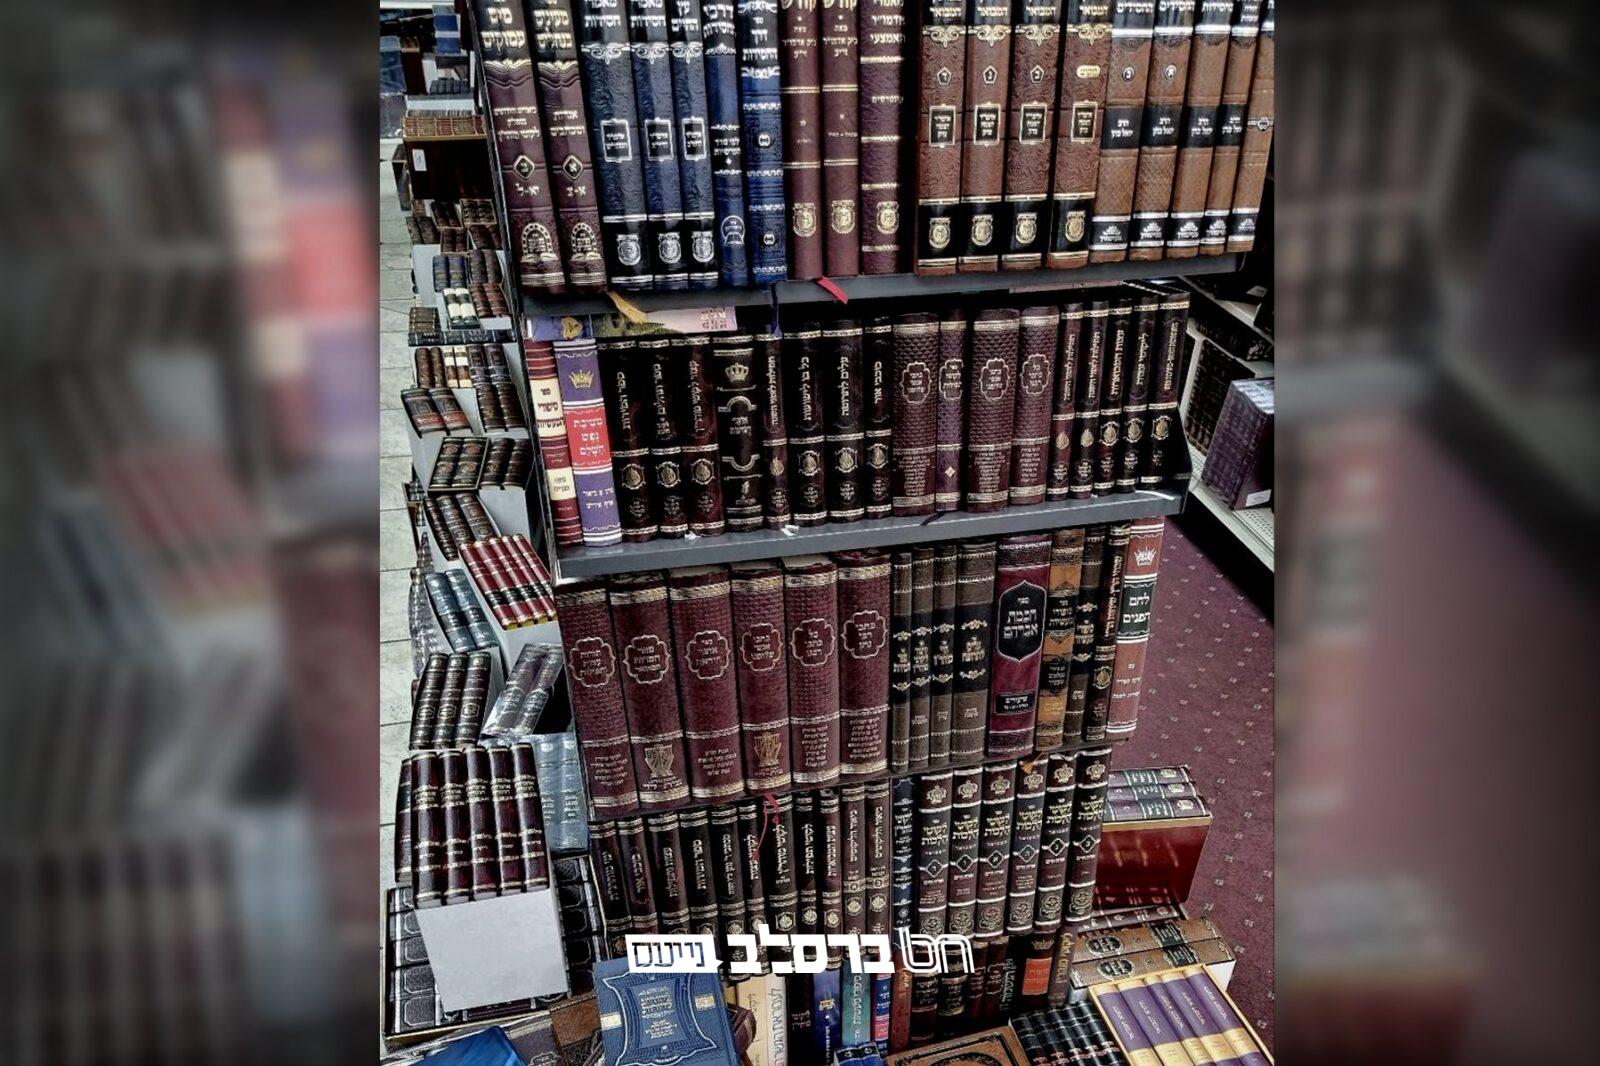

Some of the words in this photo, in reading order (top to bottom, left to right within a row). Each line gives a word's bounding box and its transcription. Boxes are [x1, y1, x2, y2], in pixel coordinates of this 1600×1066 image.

[751, 29, 768, 44] דרך
[797, 357, 809, 370] כל
[837, 357, 849, 379] עלים
[873, 361, 882, 386] כוכבי
[616, 372, 627, 393] ספר
[652, 364, 664, 384] ספר
[801, 372, 810, 382] בו
[540, 388, 551, 396] ספר
[837, 381, 850, 416] לתרופה
[873, 388, 882, 404] אור
[1129, 592, 1150, 606] לחם
[1123, 612, 1151, 623] הפנים
[772, 825, 788, 847] לקוטי
[801, 824, 815, 846] לקוטי
[692, 840, 704, 858] ספר
[631, 855, 643, 875] כוכבי
[776, 848, 790, 874] מוהר"ן
[802, 847, 815, 874] תפילות
[695, 860, 708, 889] המידות
[635, 877, 646, 893] אור
